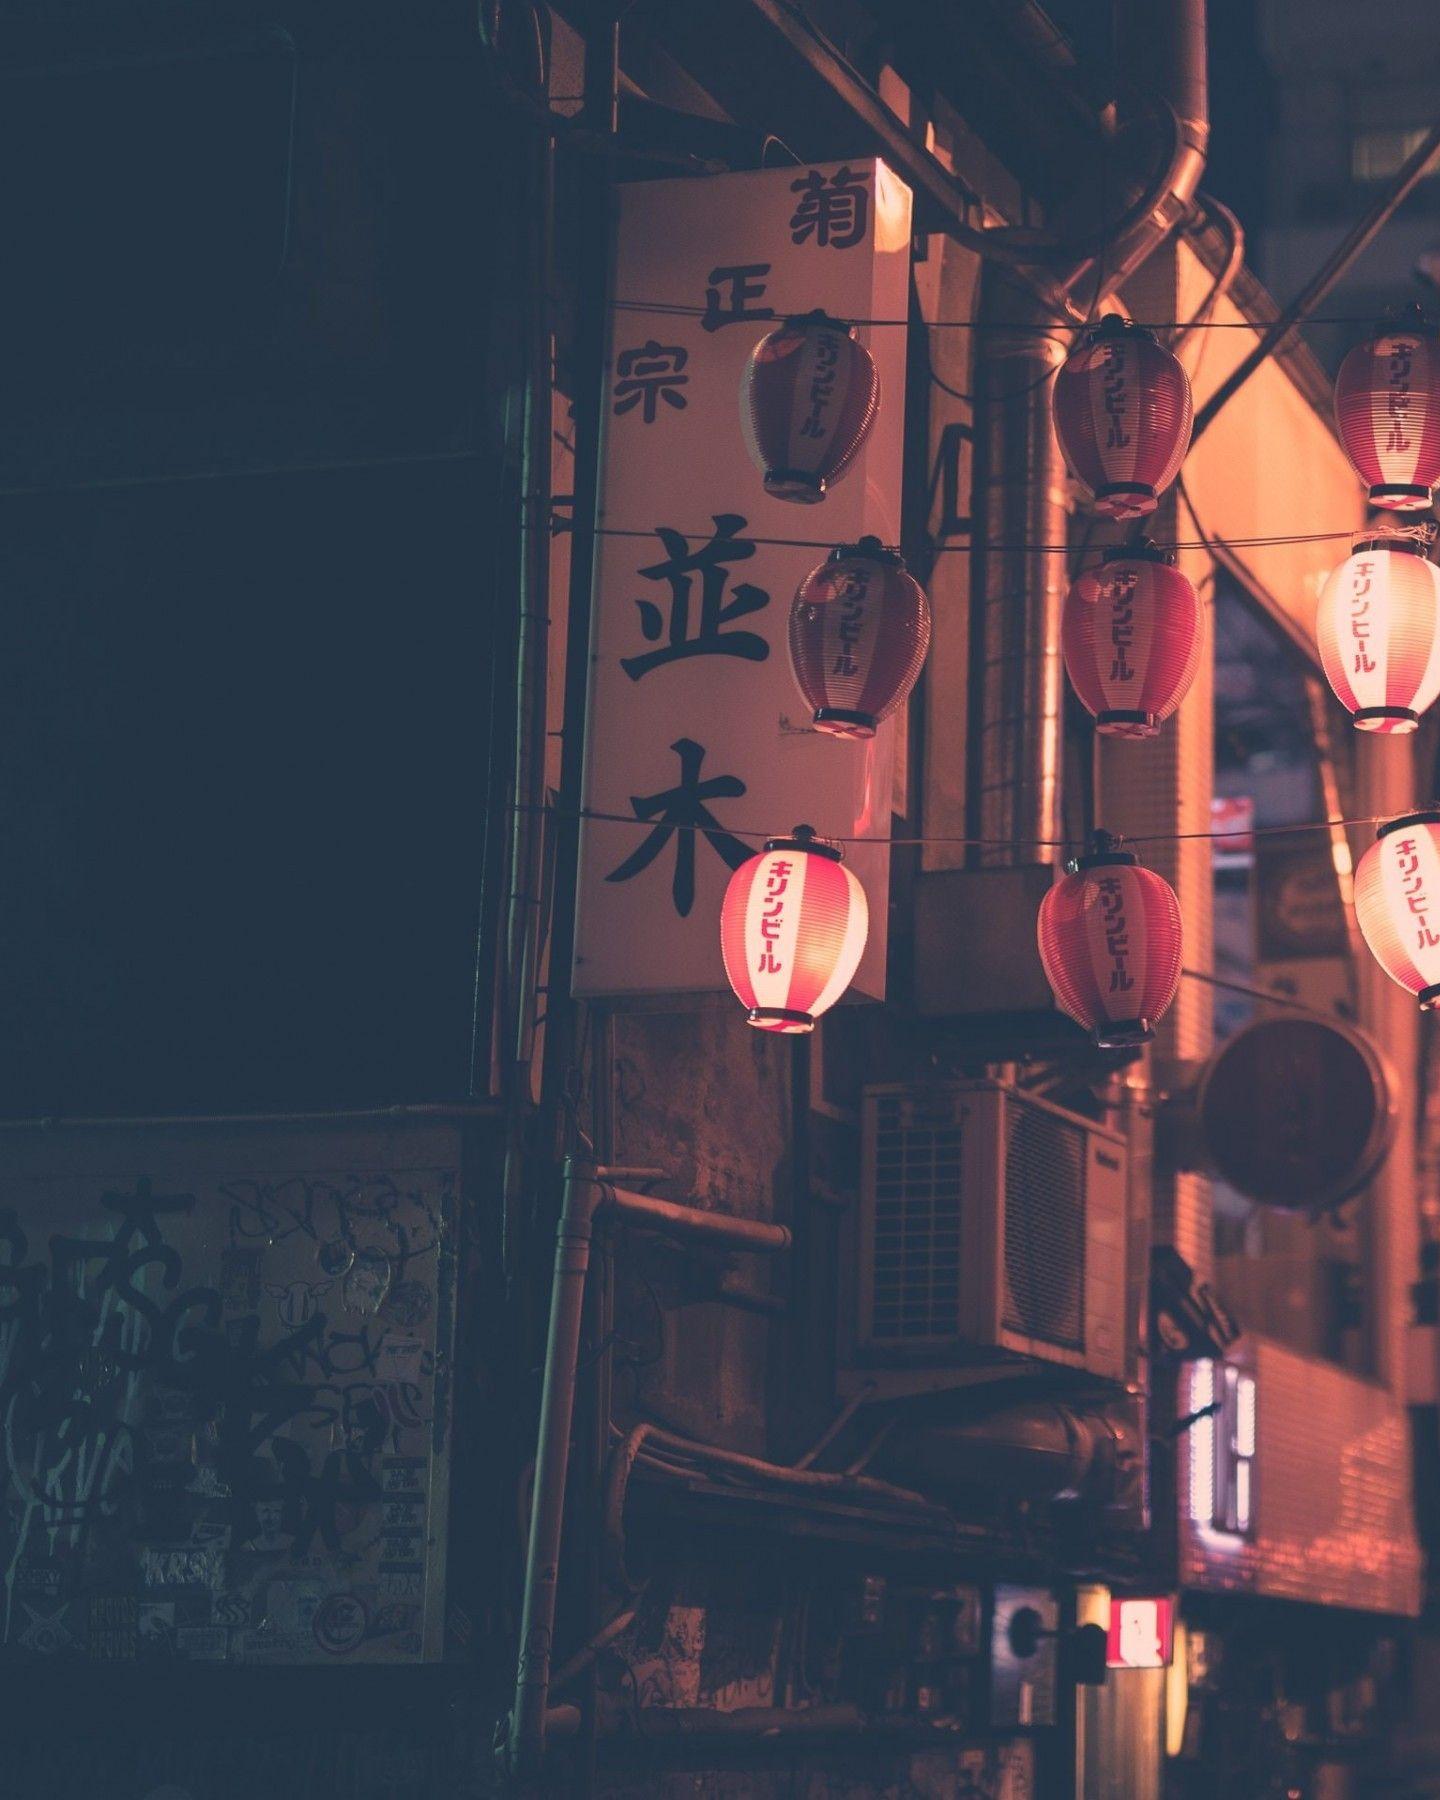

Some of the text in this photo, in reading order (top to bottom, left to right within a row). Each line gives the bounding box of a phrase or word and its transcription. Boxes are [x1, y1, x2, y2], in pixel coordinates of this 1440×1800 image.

[612, 165, 870, 424] 菊正宗
[800, 332, 841, 438] キリンビール
[1103, 342, 1131, 449] キリンビール
[832, 567, 873, 677] キリンビール
[1108, 568, 1139, 683] キリンビール
[604, 513, 771, 919] 並木
[757, 859, 795, 976] キリンビール
[1099, 876, 1135, 994] キリンビール
